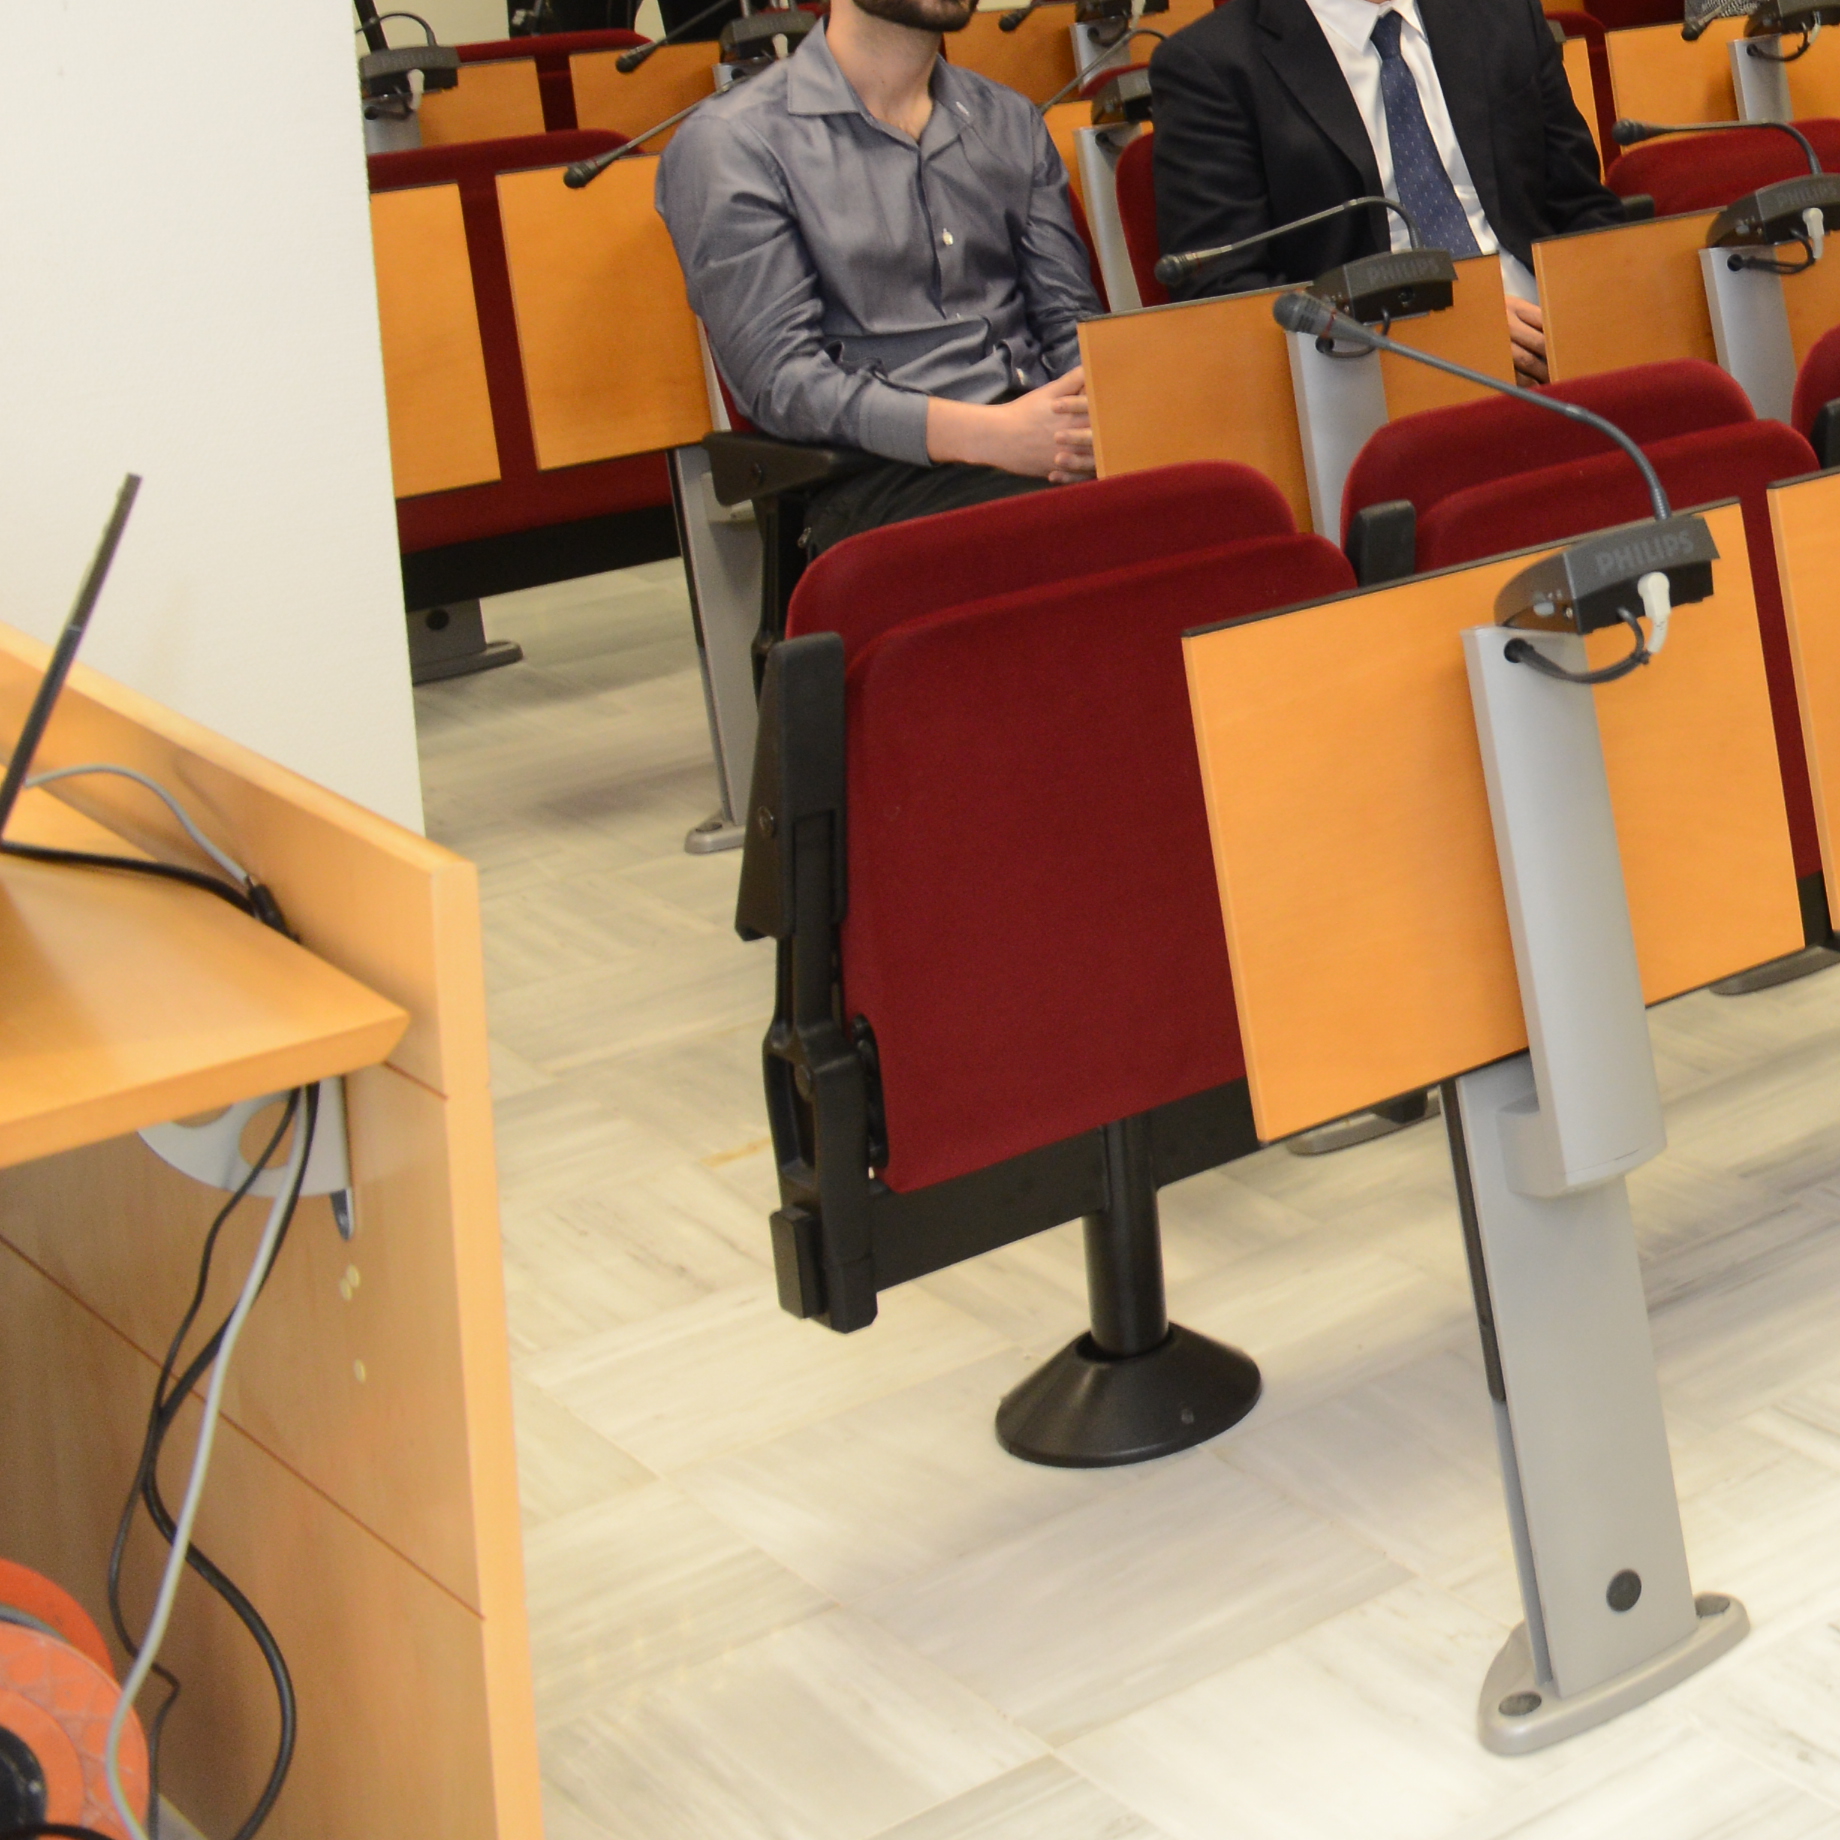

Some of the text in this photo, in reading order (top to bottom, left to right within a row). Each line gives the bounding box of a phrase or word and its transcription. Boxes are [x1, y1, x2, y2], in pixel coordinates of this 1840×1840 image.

[1776, 182, 1838, 209] PHILIPS
[1365, 258, 1440, 286] PHILIPS
[1594, 530, 1695, 576] PHILIPS
